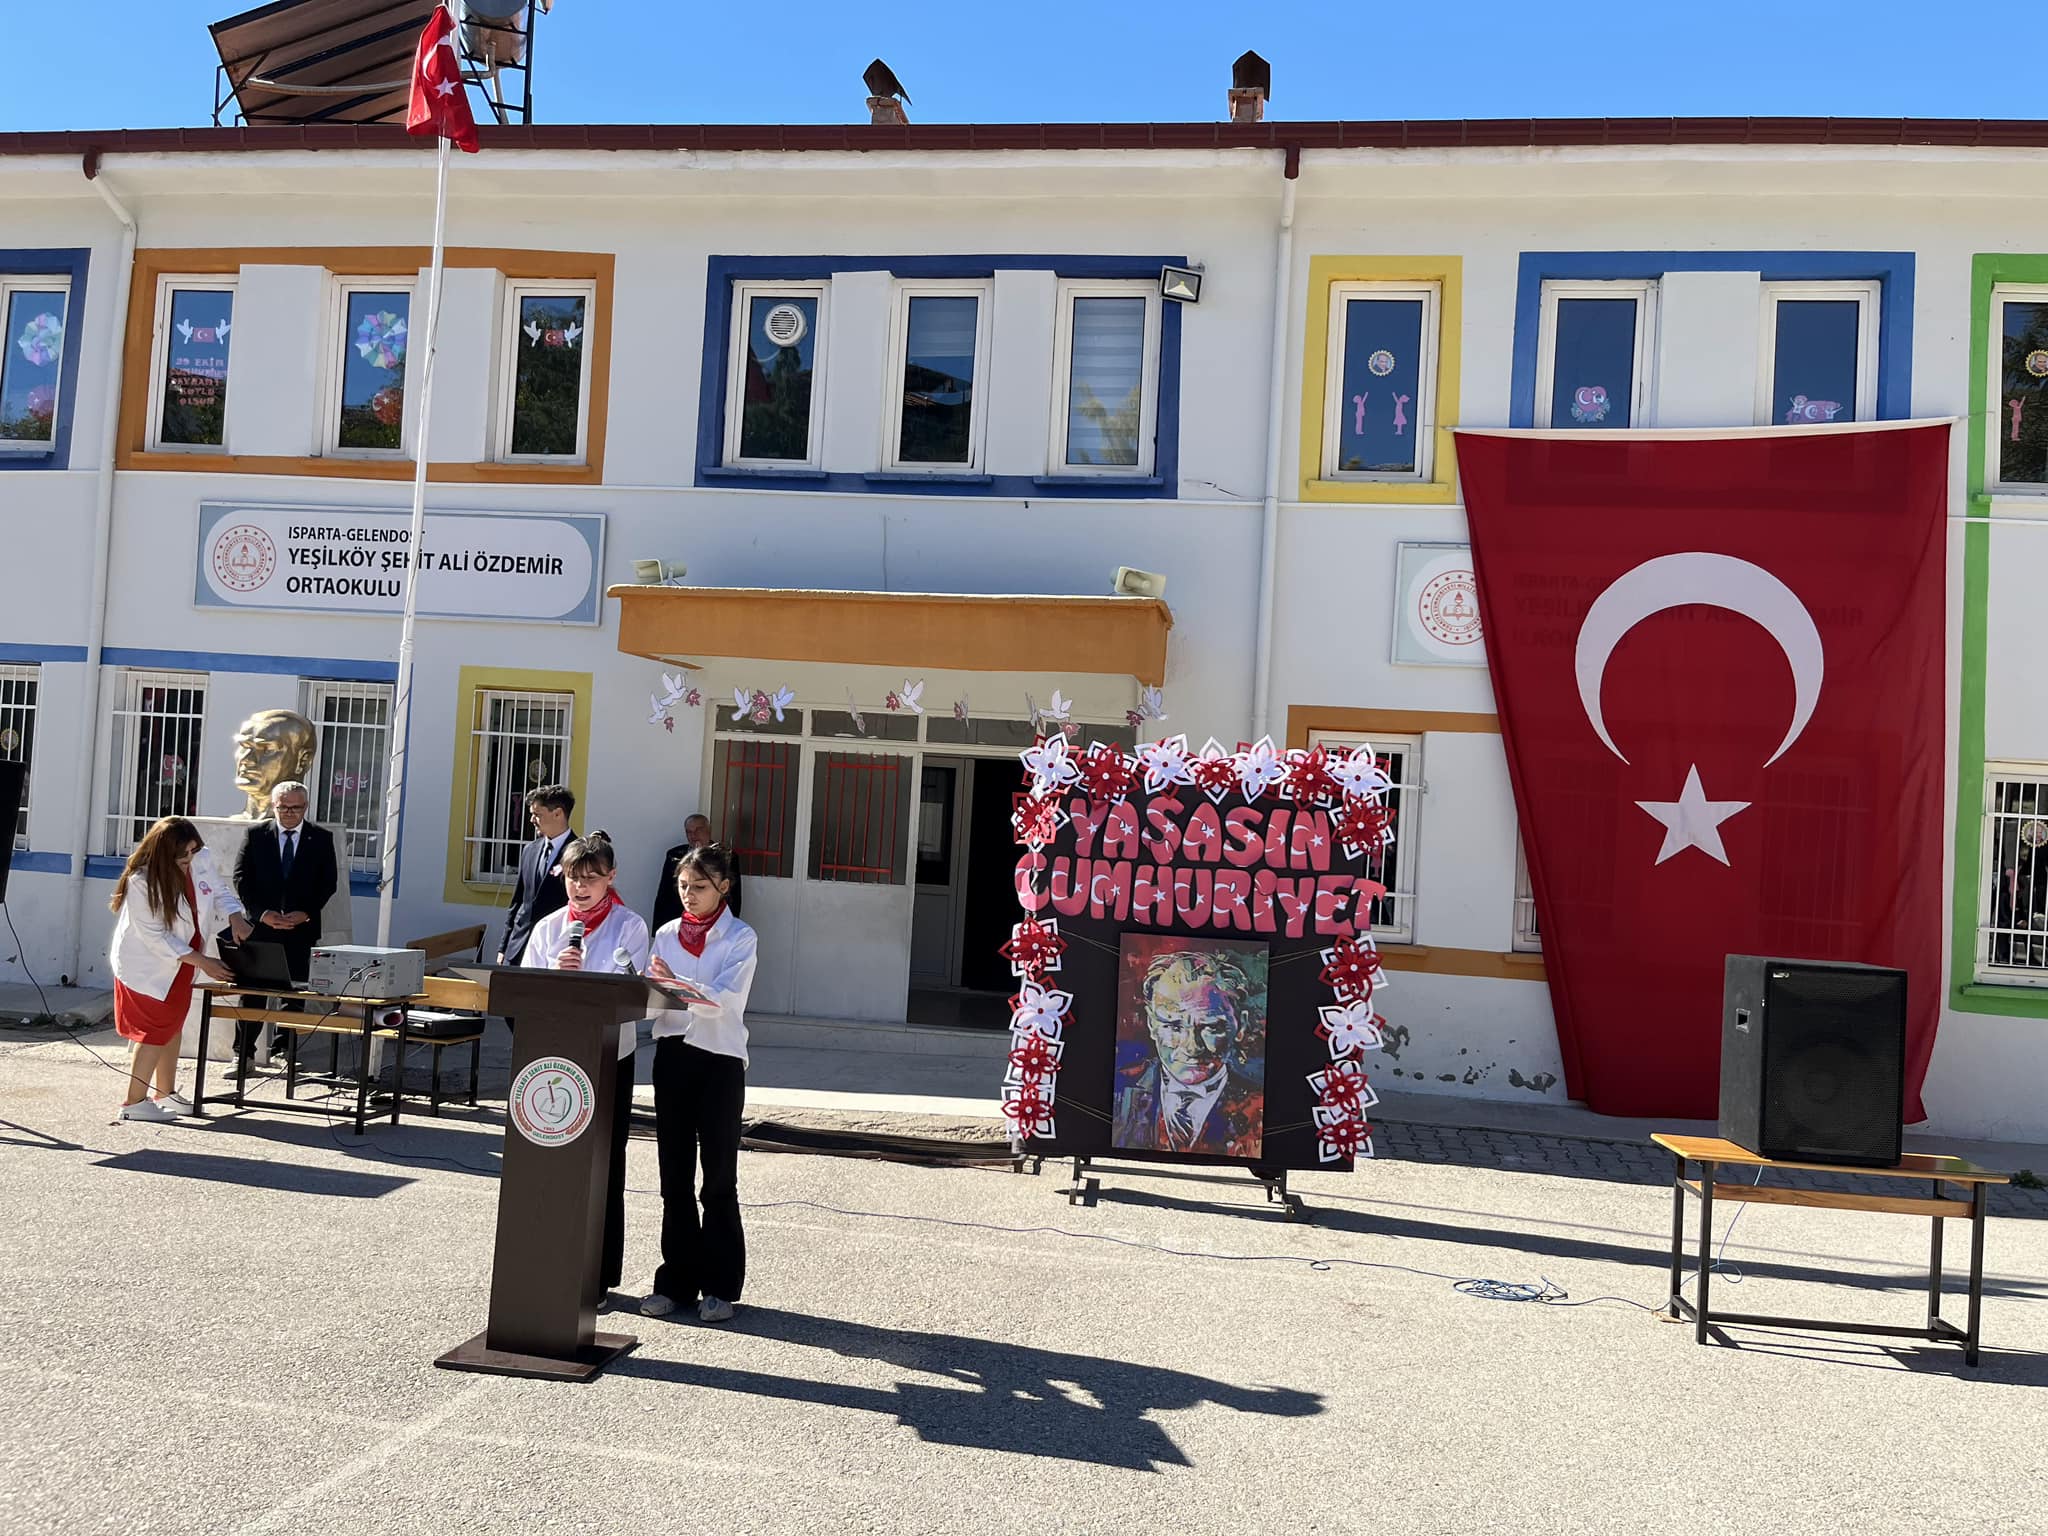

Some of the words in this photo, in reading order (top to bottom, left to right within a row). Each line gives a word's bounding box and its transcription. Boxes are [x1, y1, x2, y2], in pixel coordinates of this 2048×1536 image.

[288, 545, 377, 570] YEŞİLKÖY
[438, 550, 469, 571] ALİ
[473, 550, 563, 575] ÖZDEMİR
[286, 576, 401, 597] ORTAOKULU
